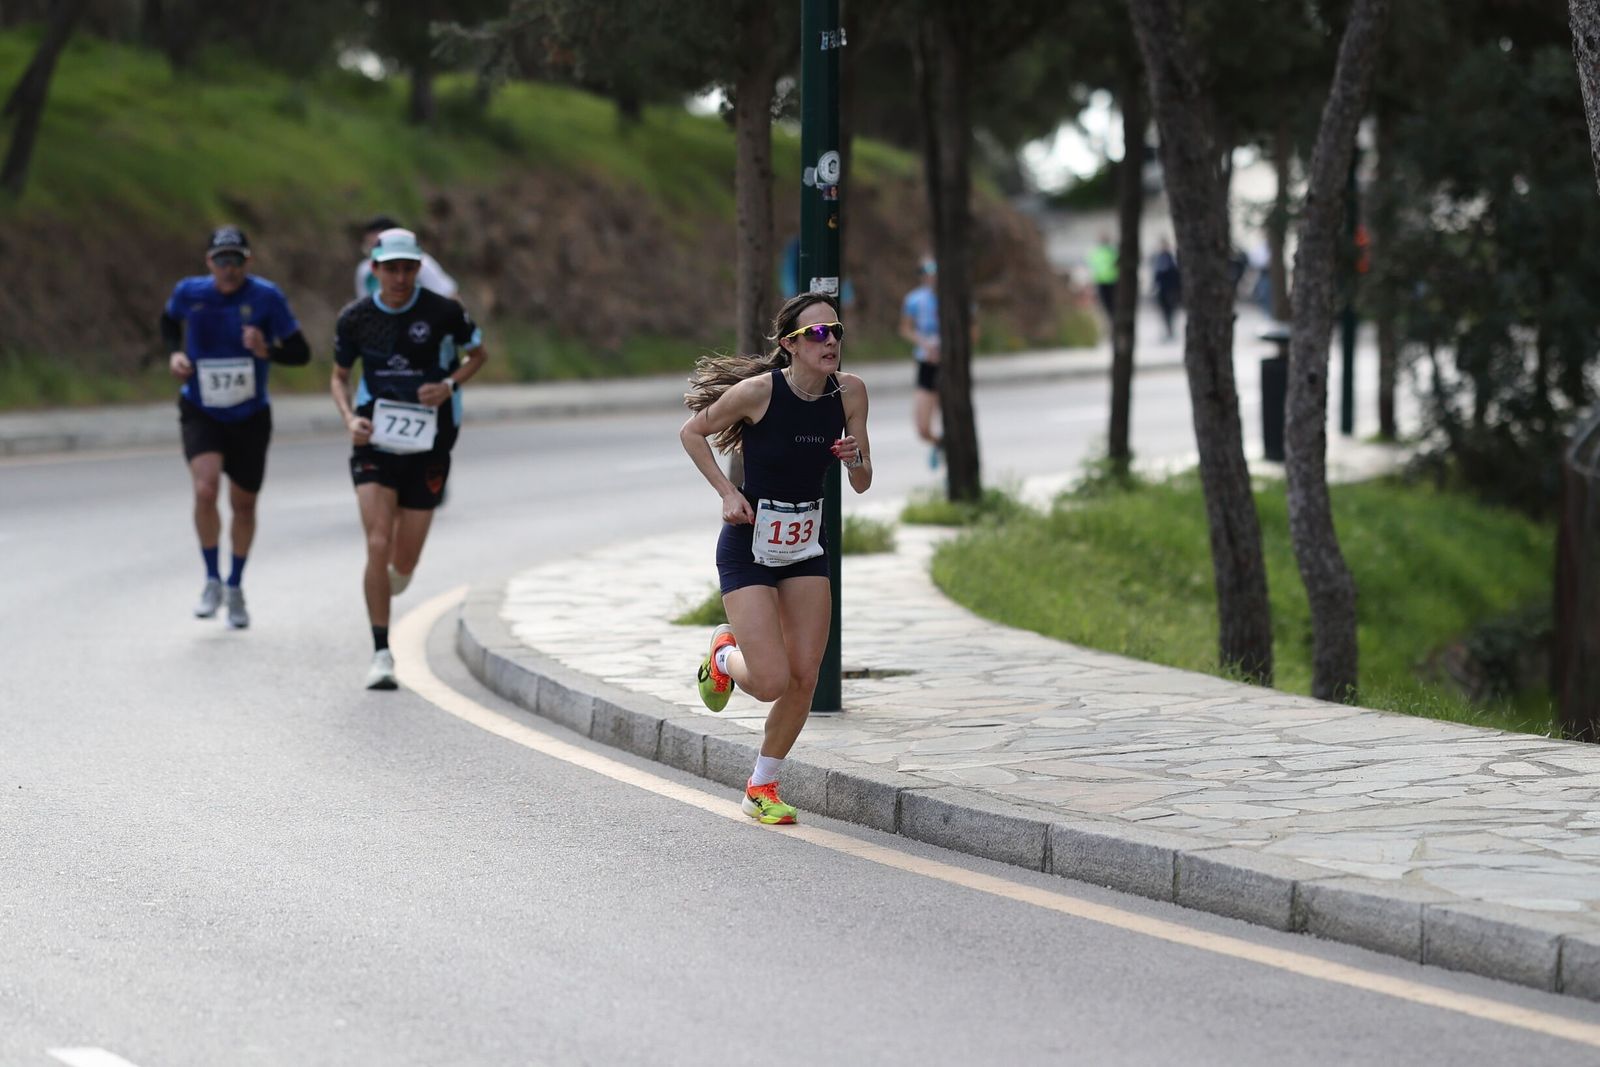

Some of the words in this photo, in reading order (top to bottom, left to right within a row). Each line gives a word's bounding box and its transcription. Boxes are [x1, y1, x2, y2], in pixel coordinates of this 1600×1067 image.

[210, 372, 246, 390] 374
[385, 415, 426, 438] 727
[795, 435, 824, 443] OYSHO
[768, 519, 813, 546] 133
